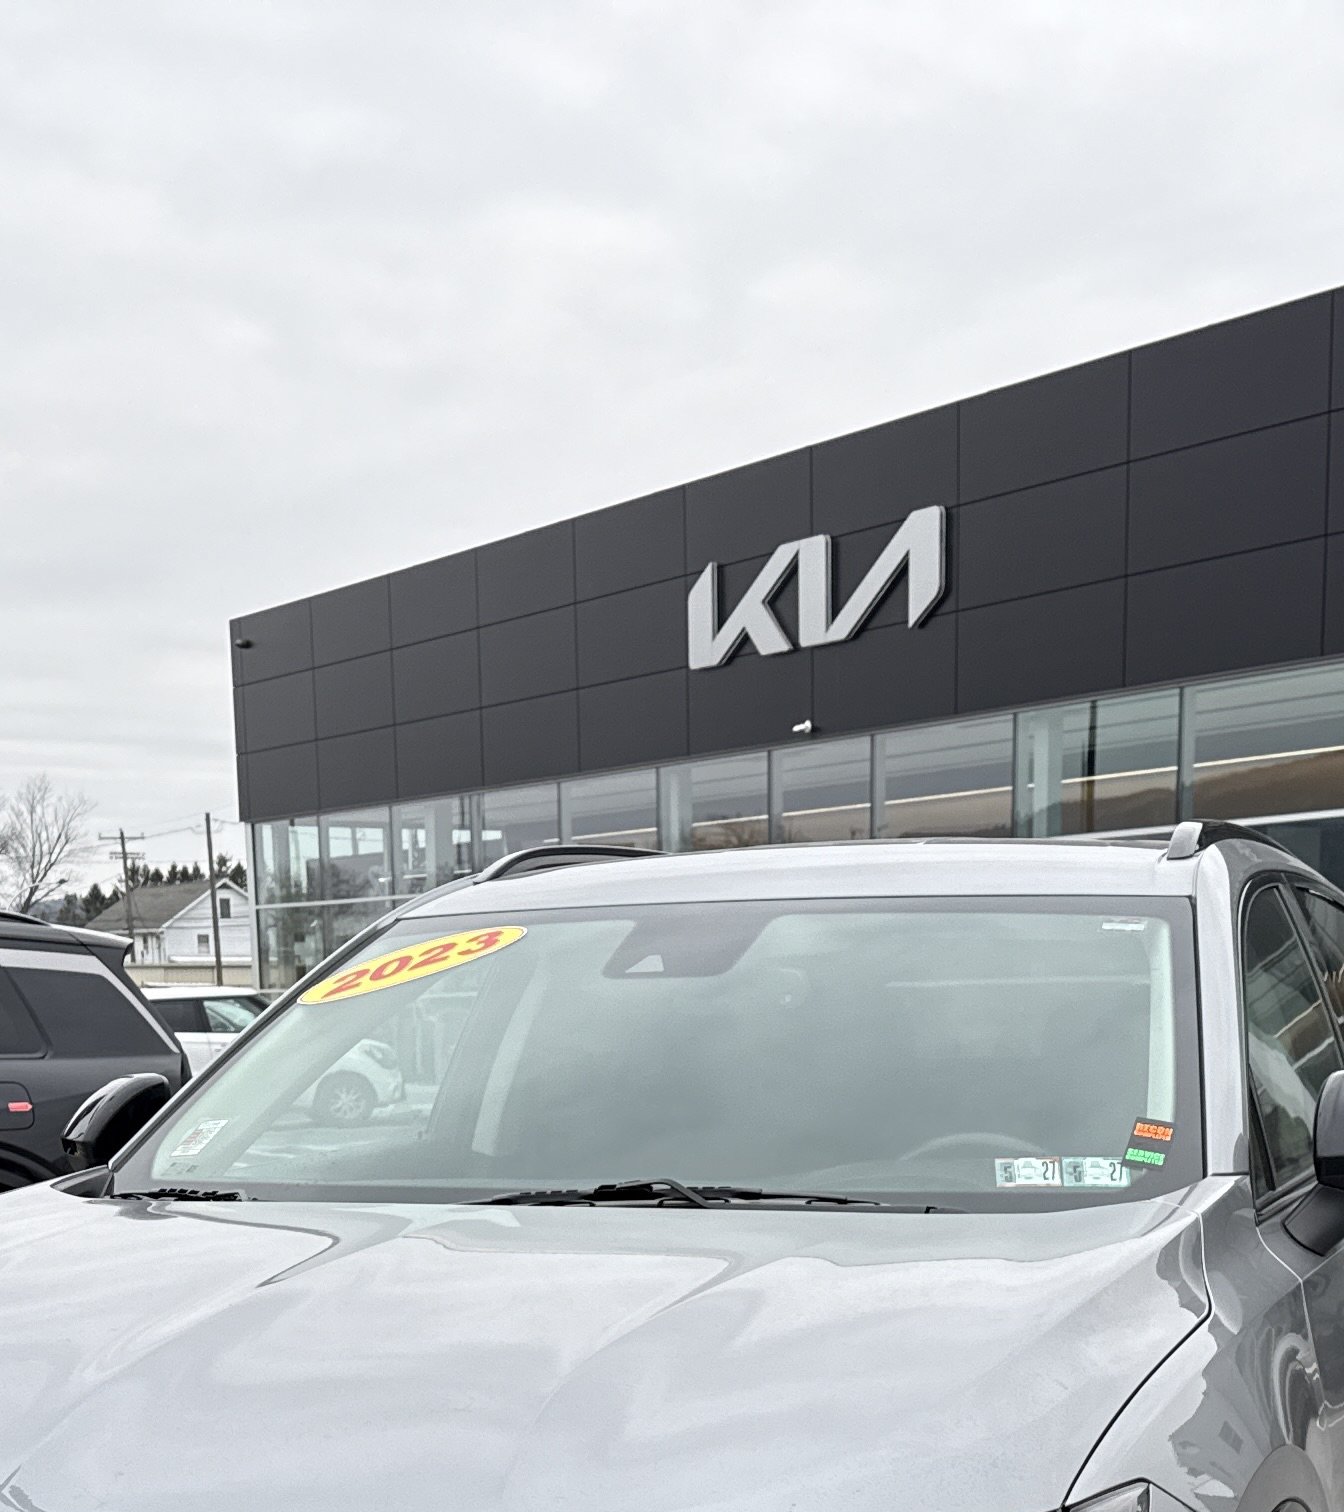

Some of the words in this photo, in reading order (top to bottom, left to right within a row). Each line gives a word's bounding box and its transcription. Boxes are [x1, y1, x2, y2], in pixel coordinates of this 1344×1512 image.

[688, 505, 946, 670] KIA
[320, 930, 504, 999] 2023
[1042, 1161, 1056, 1181] 27
[1109, 1161, 1123, 1182] 27
